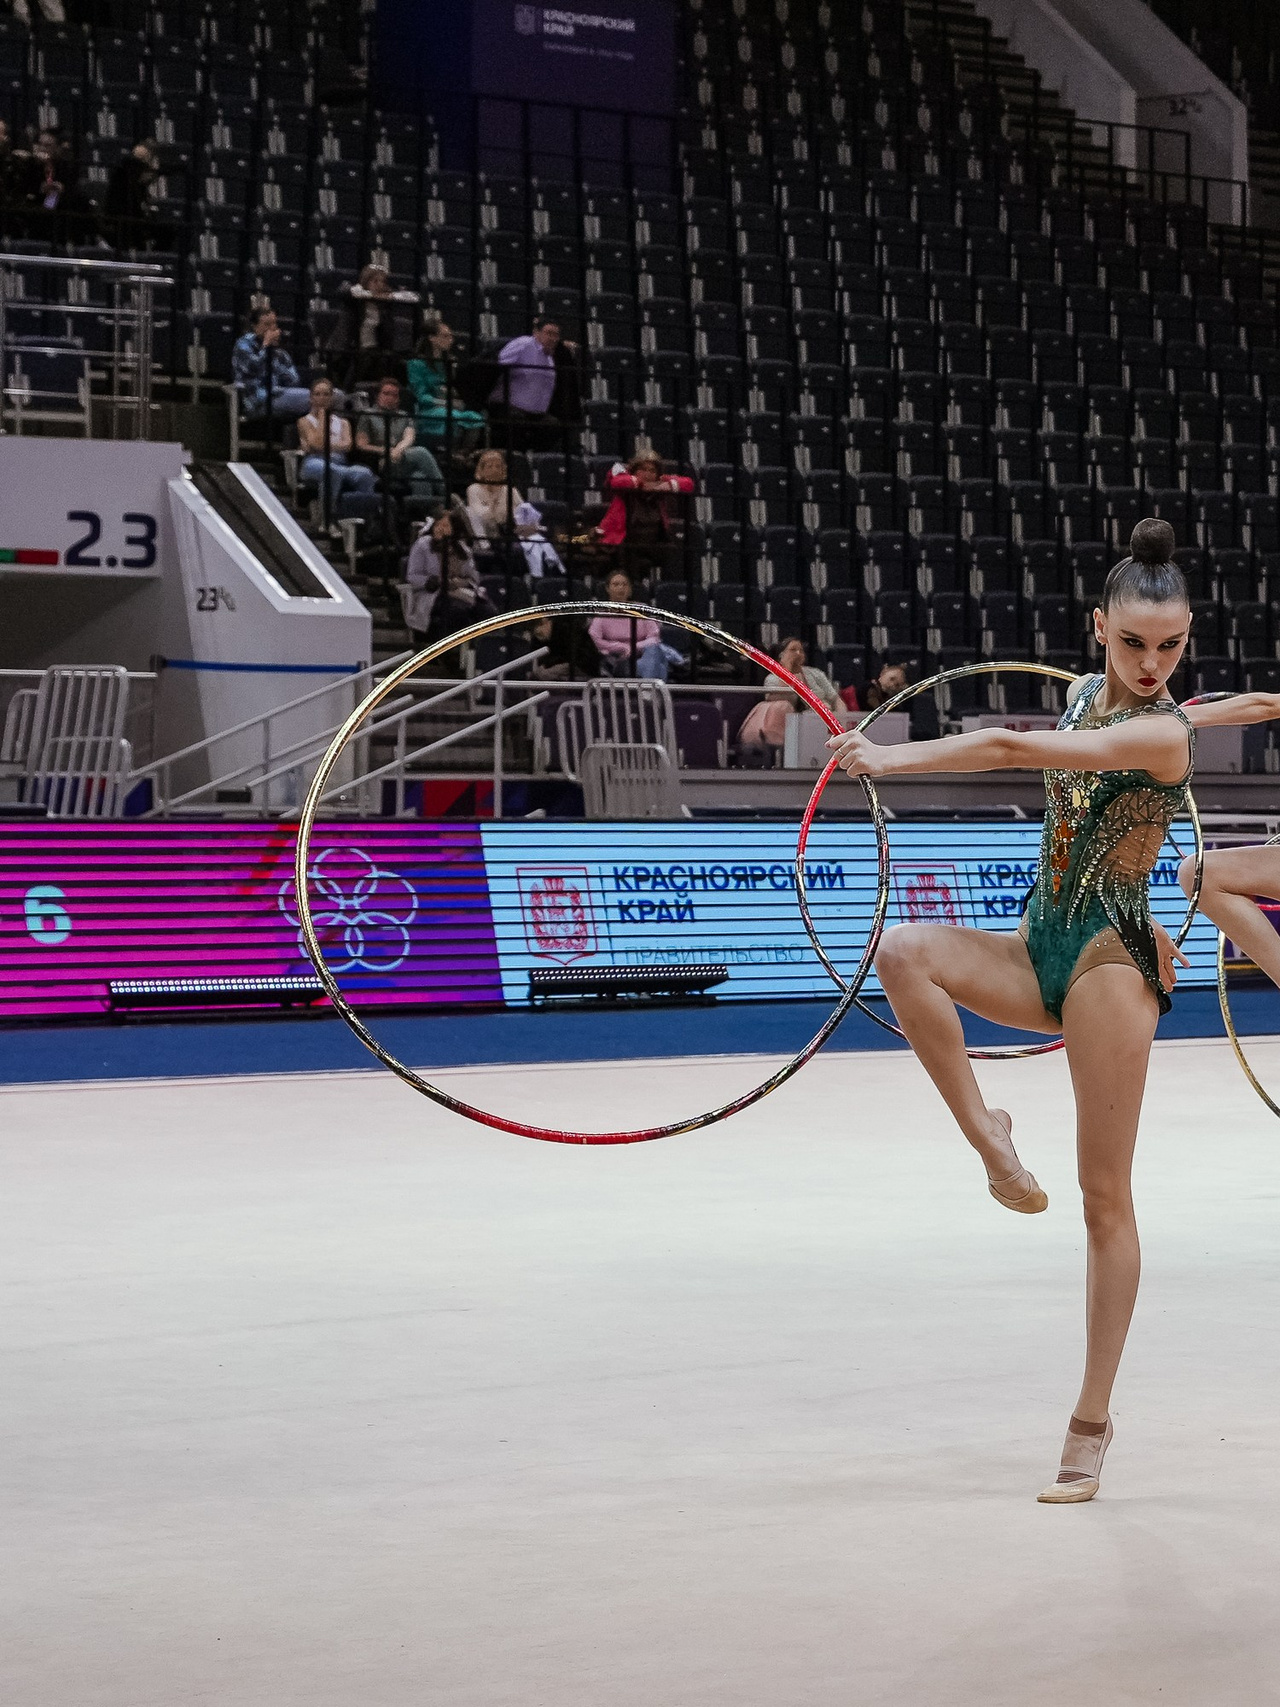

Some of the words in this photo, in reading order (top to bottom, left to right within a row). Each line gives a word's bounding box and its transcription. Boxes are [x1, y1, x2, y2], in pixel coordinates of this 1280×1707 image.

[66, 510, 157, 568] 2.3
[24, 885, 72, 944] 6
[617, 890, 696, 922] КРАЙ
[624, 943, 804, 965] ПРАВИТЕЛЬСТВО
